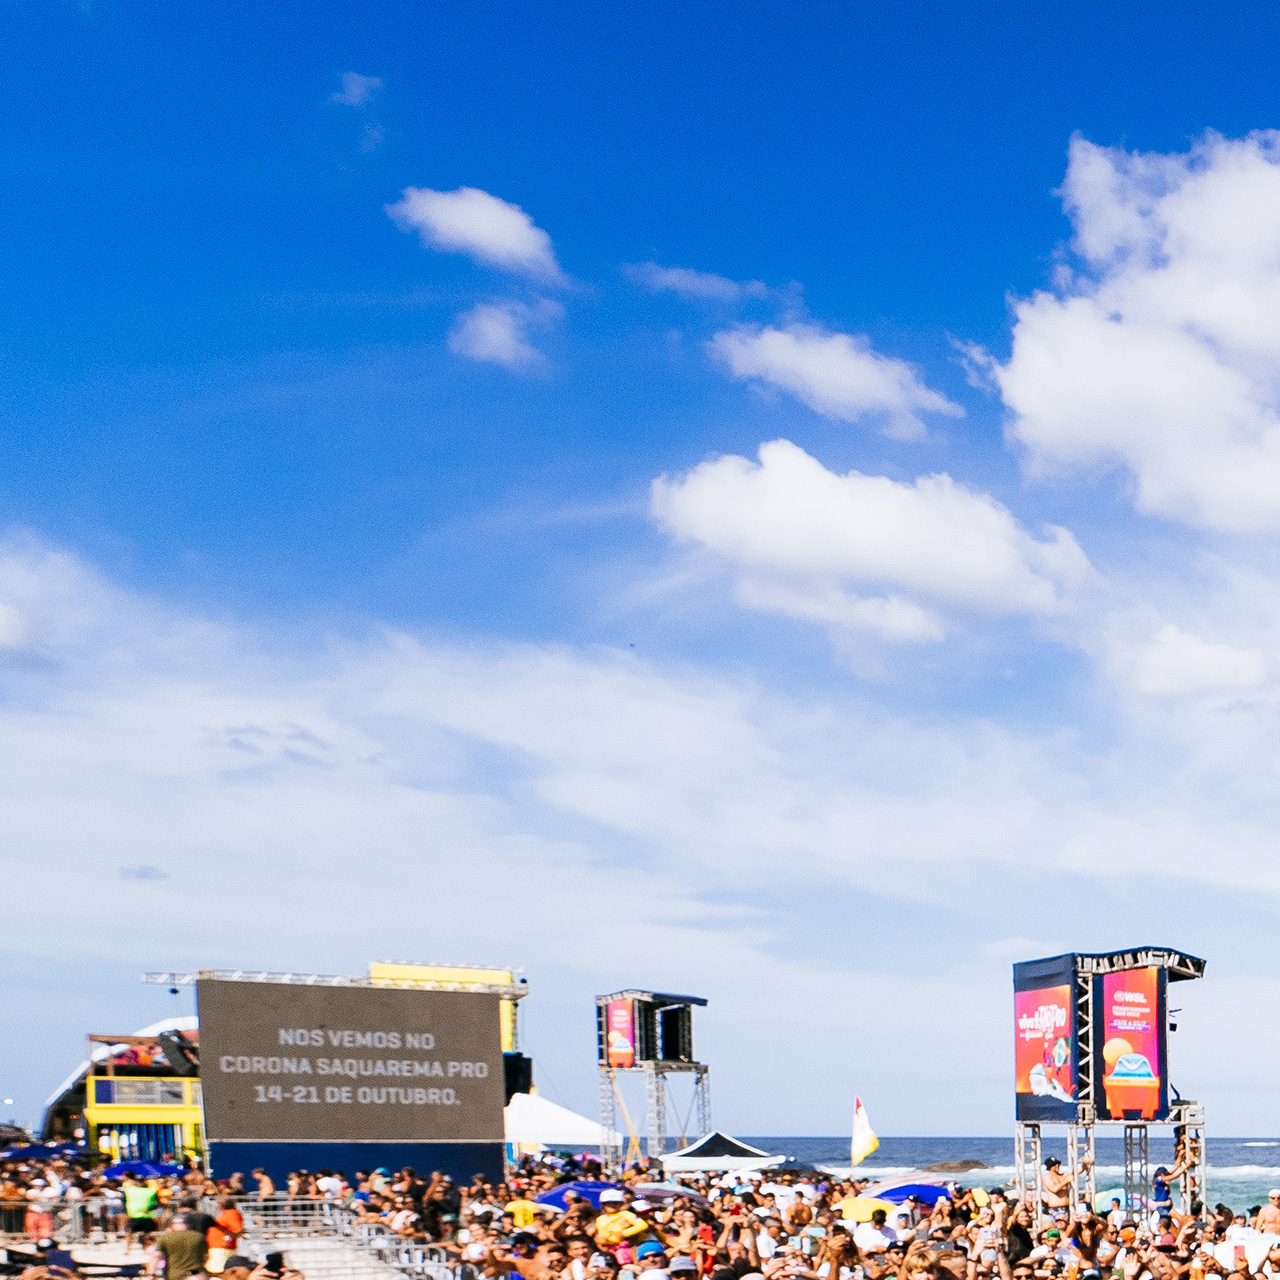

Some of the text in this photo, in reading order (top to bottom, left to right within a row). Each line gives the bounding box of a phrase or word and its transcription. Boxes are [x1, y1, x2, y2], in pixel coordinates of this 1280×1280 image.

[278, 1028, 436, 1050] NOS VEMOS NO
[219, 1055, 489, 1079] CORONA SAQUAREMA PRO
[254, 1085, 462, 1106] 14-21 DE OUTUBRO.
